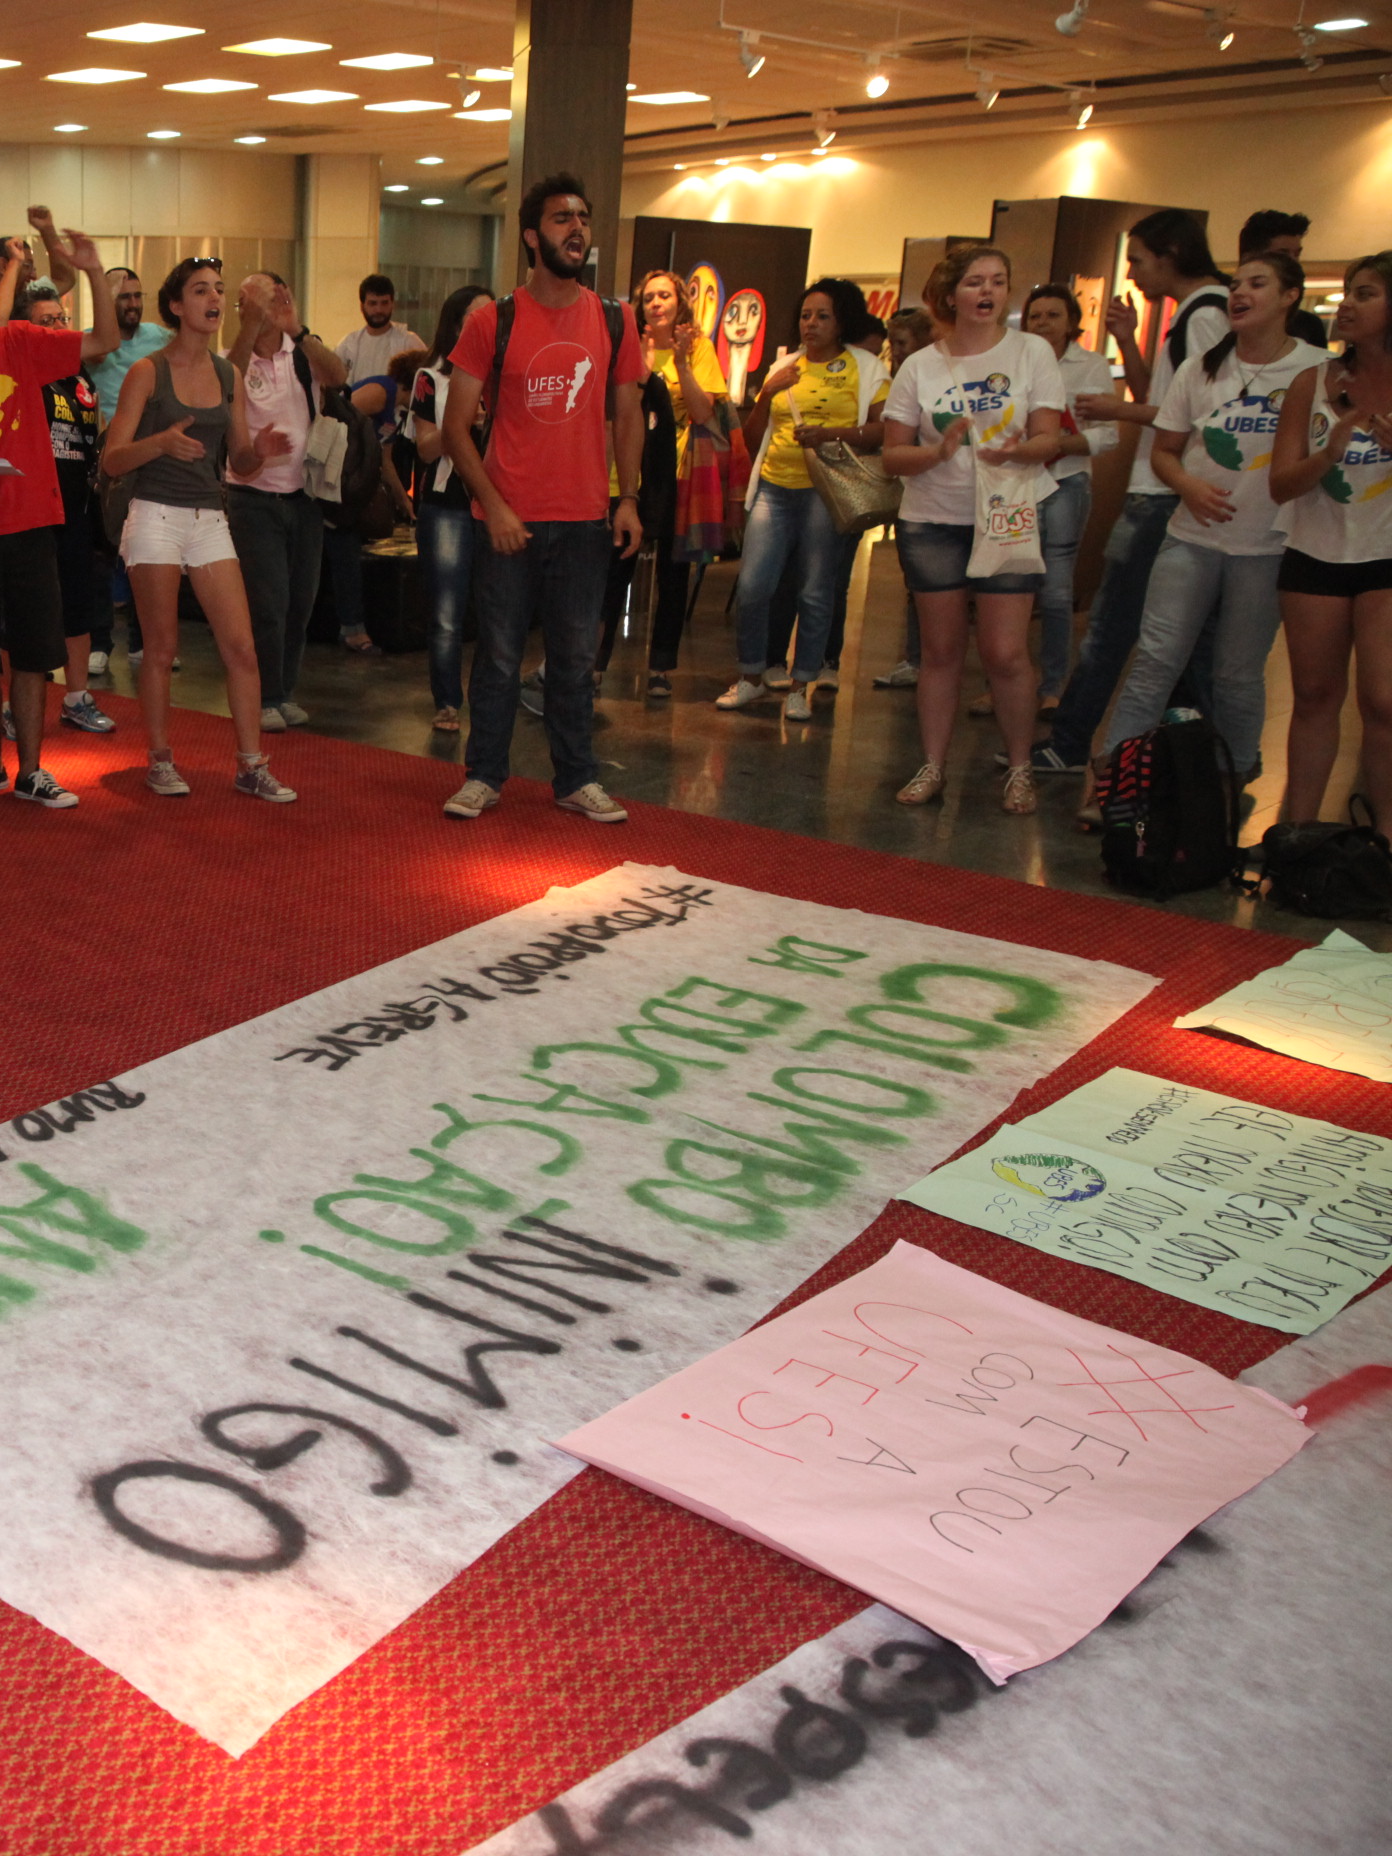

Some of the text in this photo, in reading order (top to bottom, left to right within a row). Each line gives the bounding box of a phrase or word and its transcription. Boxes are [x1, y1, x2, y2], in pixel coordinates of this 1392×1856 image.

[528, 375, 565, 393] UFES
[950, 395, 1004, 413] UBES
[1224, 416, 1279, 433] UBES
[1343, 447, 1392, 466] BES
[748, 934, 870, 980] DA
[274, 995, 469, 1071] GREVE
[12, 1080, 146, 1142] RUMO
[627, 962, 1065, 1241] COLOMBO
[1042, 1167, 1079, 1191] UBES
[1203, 1183, 1316, 1244] MEXEU
[1146, 1232, 1241, 1282] COM
[1215, 1262, 1344, 1319] MEU
[680, 1302, 975, 1465] UFES!
[836, 1351, 1035, 1476] COM A
